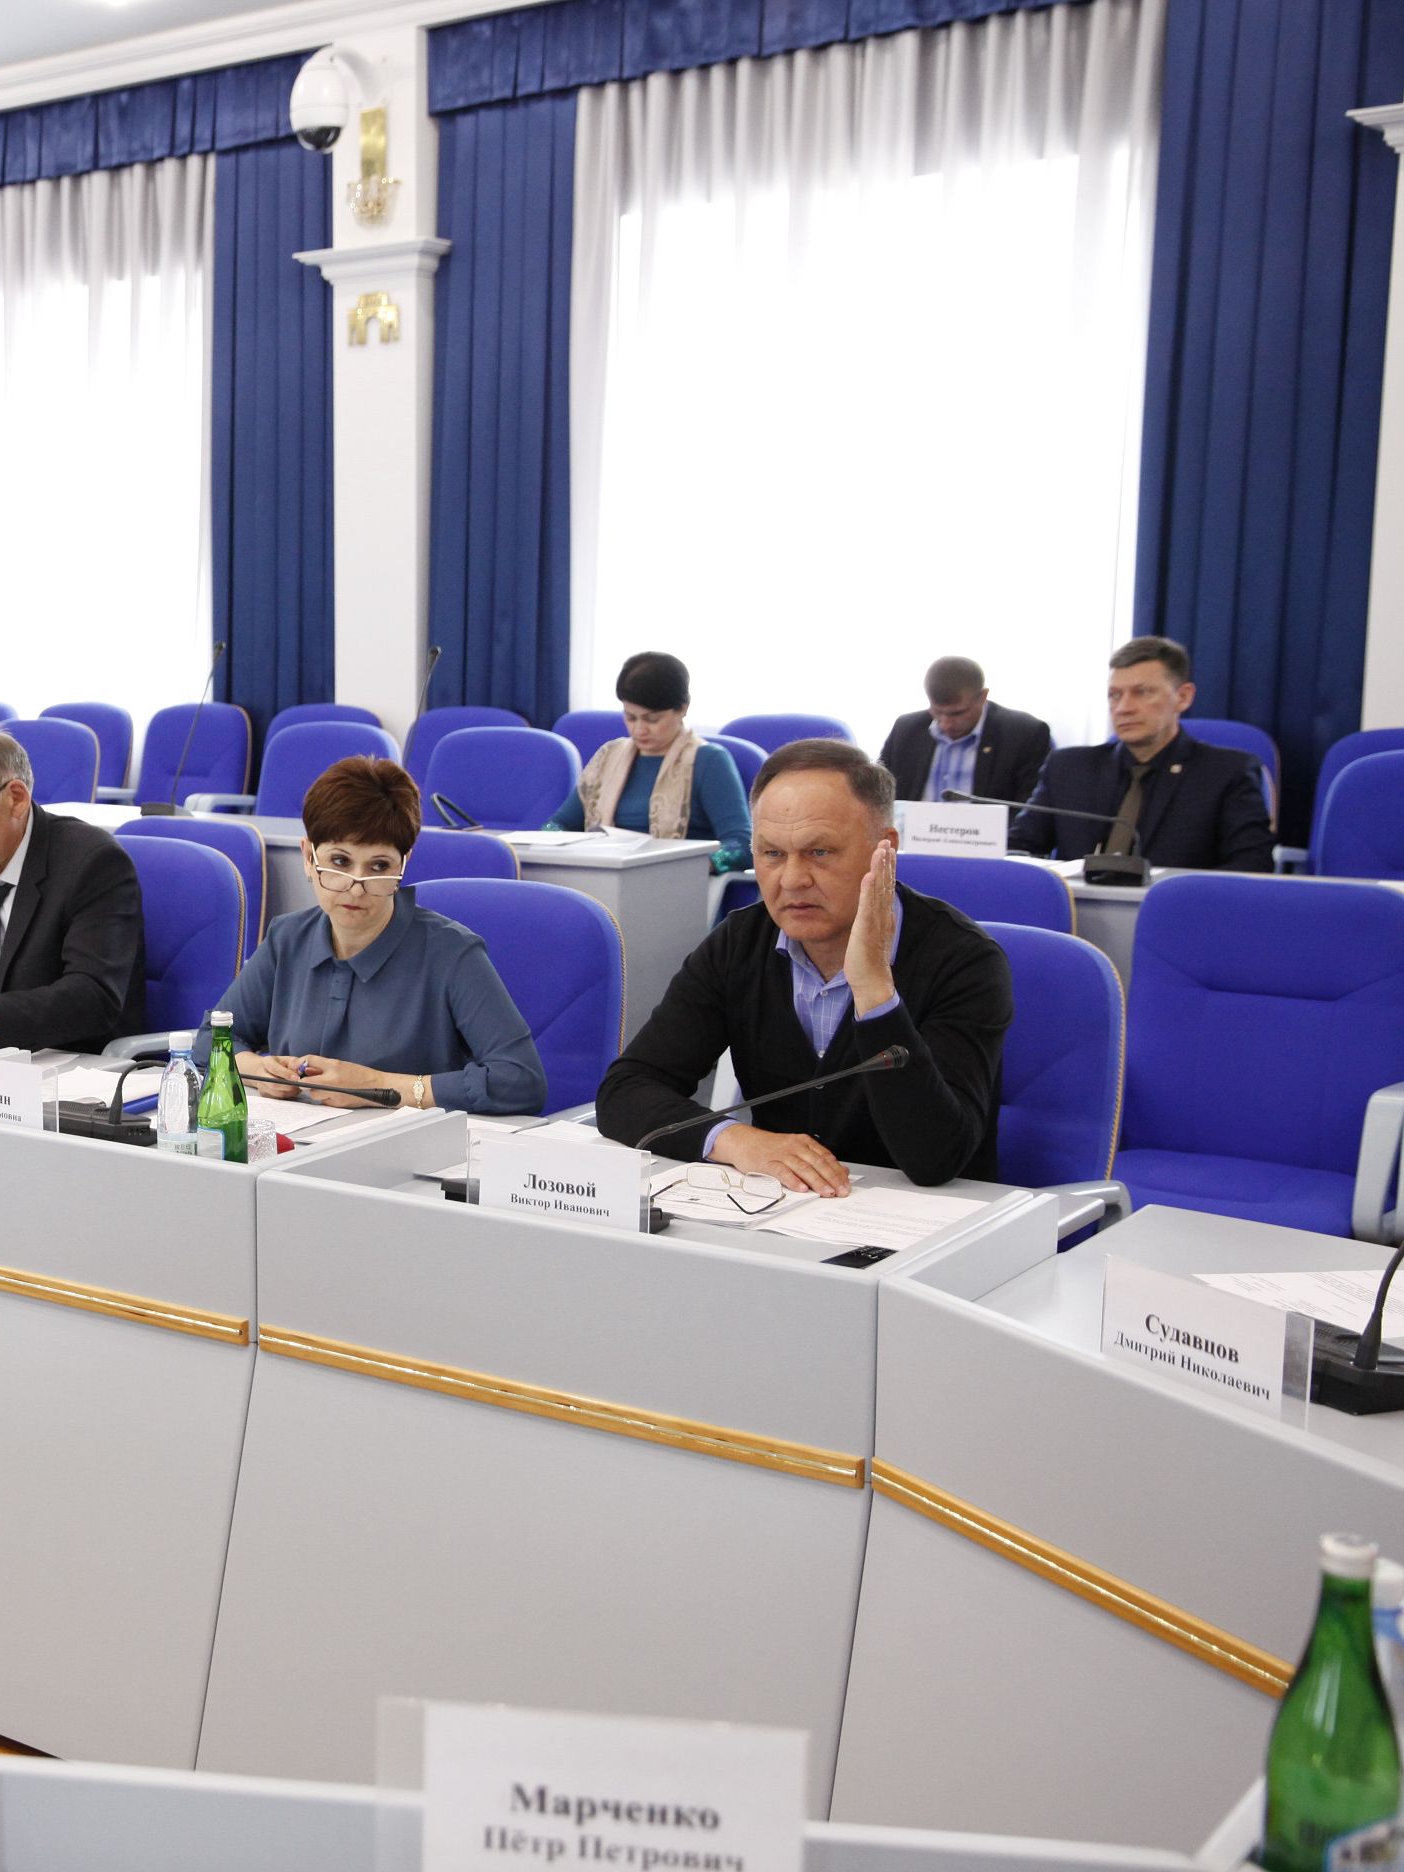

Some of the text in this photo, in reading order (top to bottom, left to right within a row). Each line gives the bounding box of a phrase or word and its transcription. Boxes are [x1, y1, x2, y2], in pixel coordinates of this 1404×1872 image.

[510, 1192, 610, 1218] Виктор Иванович
[523, 1172, 597, 1199] Лозовой
[1144, 1312, 1240, 1364] Судавцов
[1113, 1330, 1271, 1402] Дмитрий Николаевич
[509, 1781, 722, 1832] Марченко
[484, 1824, 745, 1872] Пётр Петрович
